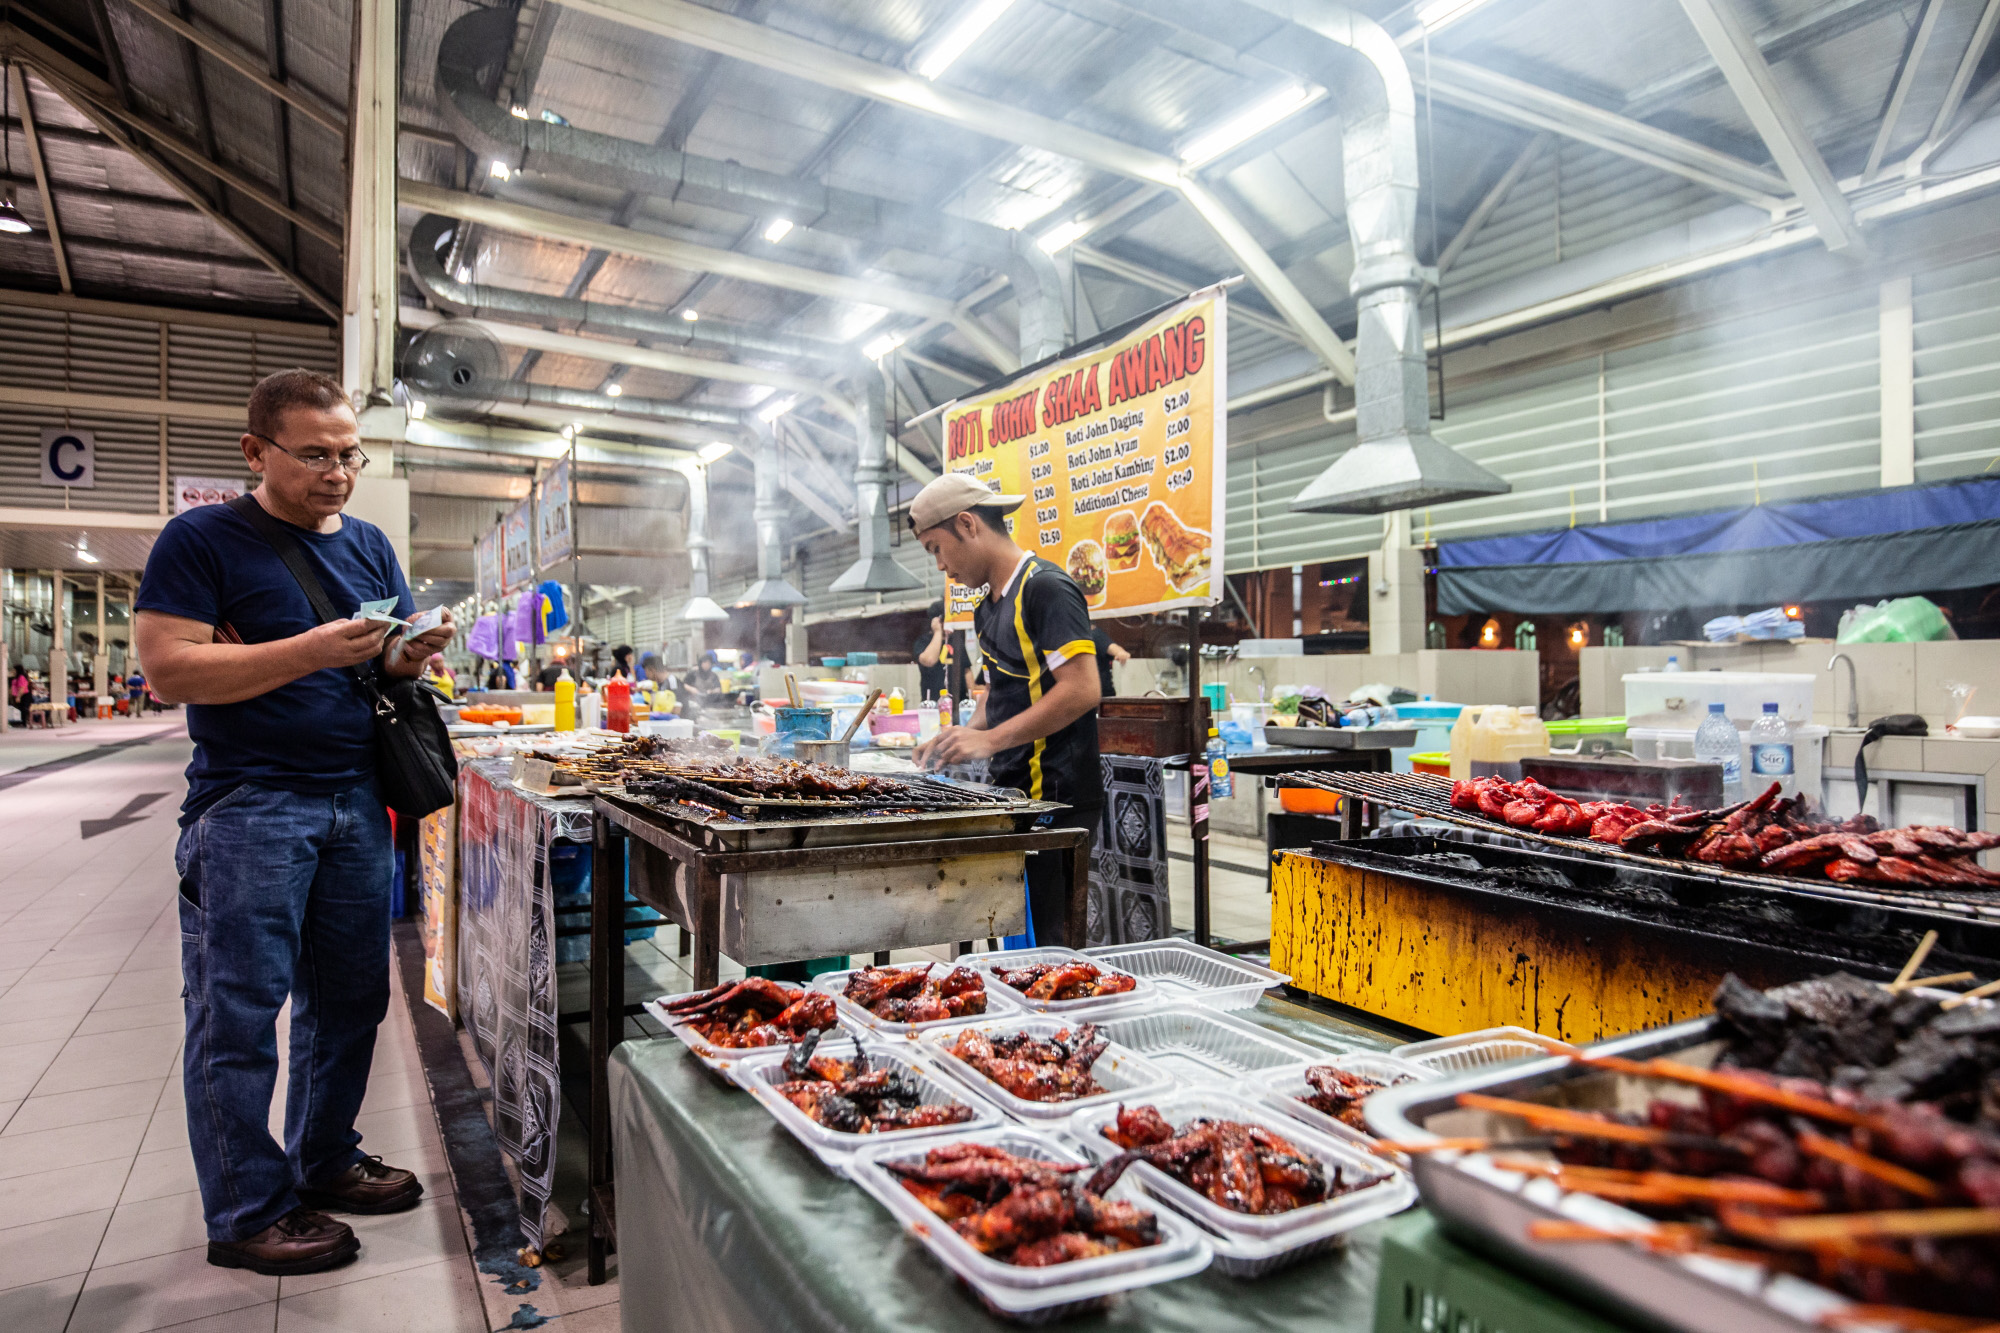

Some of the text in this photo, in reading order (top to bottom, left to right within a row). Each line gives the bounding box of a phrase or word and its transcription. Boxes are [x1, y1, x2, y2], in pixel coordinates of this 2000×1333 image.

[948, 316, 1205, 462] ROTI JOHN SHAA AWANG
[1164, 391, 1189, 413] $2.00
[1066, 411, 1143, 446] Roti John Daging
[49, 435, 85, 481] C
[1030, 442, 1049, 458] $1.00
[1068, 440, 1138, 469] Roti John Ayam
[1164, 444, 1189, 465] $2.00
[1031, 464, 1051, 480] $2.00
[1070, 458, 1155, 492] Roti John Kambing
[1034, 486, 1054, 501] $2.00
[1074, 485, 1148, 515] Additional Cheese
[1037, 508, 1057, 523] $2.00
[1040, 530, 1060, 545] $2.50
[950, 584, 976, 598] Burger
